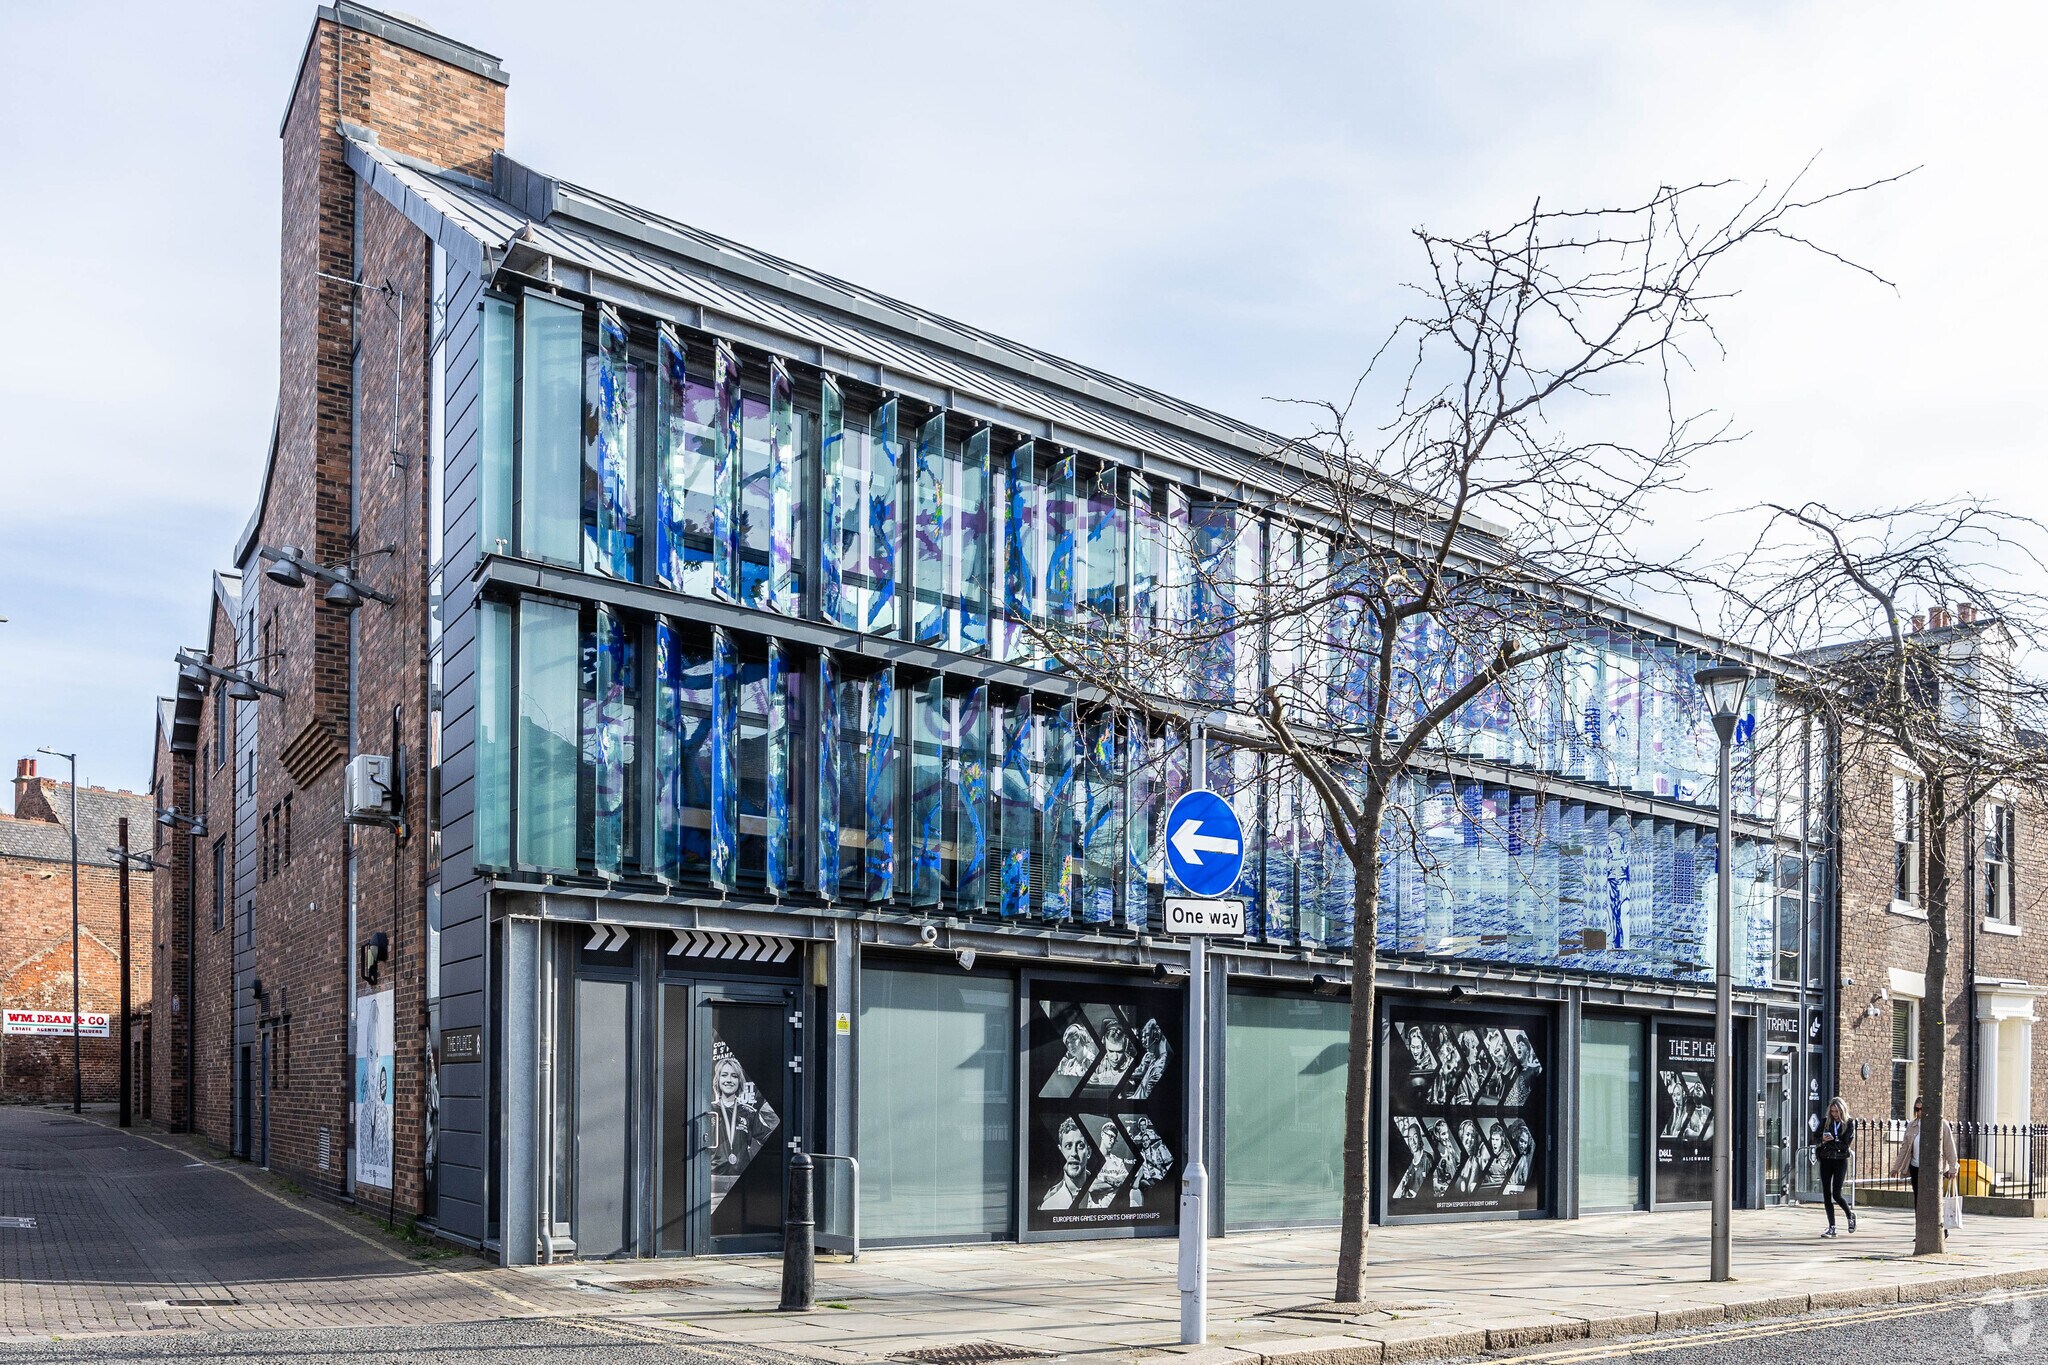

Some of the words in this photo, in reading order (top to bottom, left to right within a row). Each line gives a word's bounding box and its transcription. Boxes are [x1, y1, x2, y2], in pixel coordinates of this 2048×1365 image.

[1172, 907, 1204, 923] One
[1209, 912, 1239, 928] way
[7, 1013, 35, 1022] WM.
[36, 1014, 72, 1024] DEAN
[88, 1016, 107, 1026] CO.
[1766, 1017, 1798, 1033] TRANCE
[446, 1036, 456, 1051] THE
[1668, 1039, 1690, 1056] THE
[1052, 1215, 1080, 1223] EUROPEAN
[1080, 1214, 1097, 1222] GAMES
[1097, 1213, 1120, 1221] ESPORTS
[1120, 1212, 1160, 1220] CHAMPIONSHIPS
